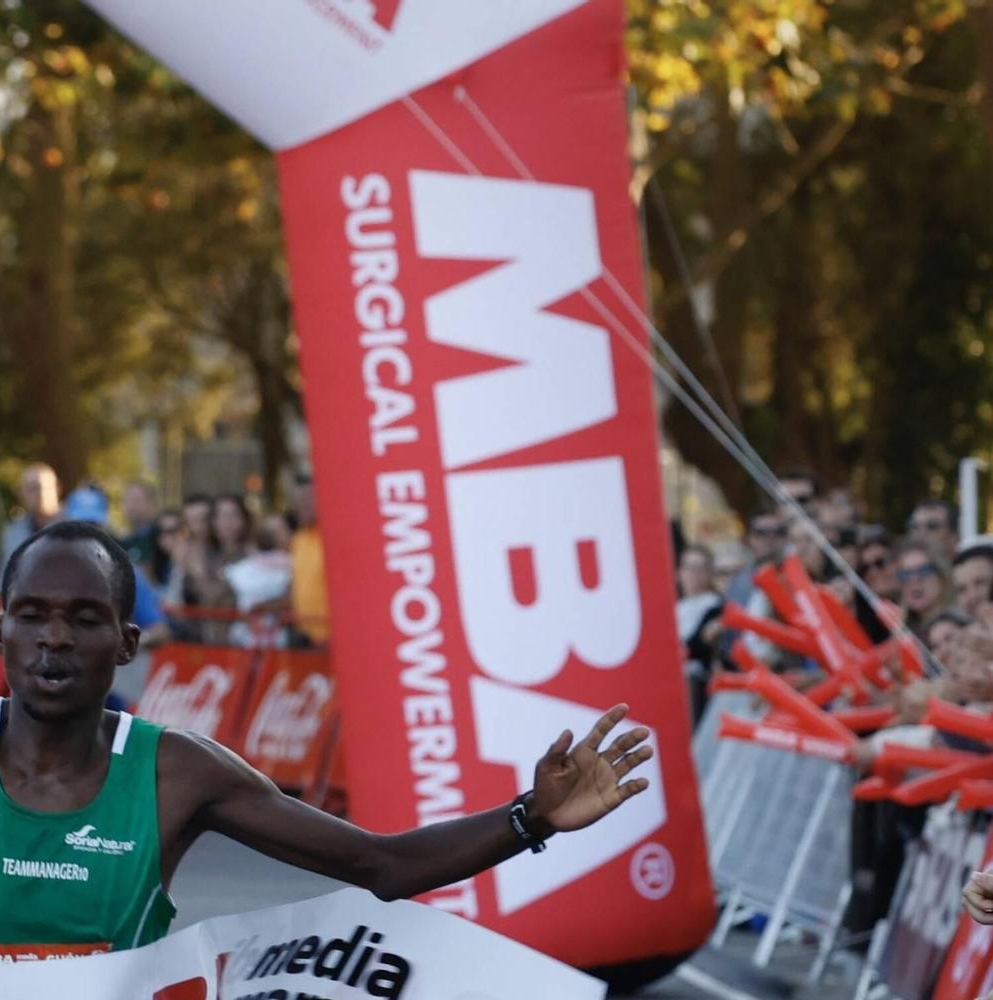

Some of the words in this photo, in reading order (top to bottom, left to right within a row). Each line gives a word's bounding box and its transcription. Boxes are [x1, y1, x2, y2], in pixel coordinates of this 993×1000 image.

[340, 173, 419, 455] SURGICAL
[375, 469, 478, 919] EMPOWERMT
[408, 168, 668, 917] MBA
[2, 857, 89, 881] TEAMMANAGER10
